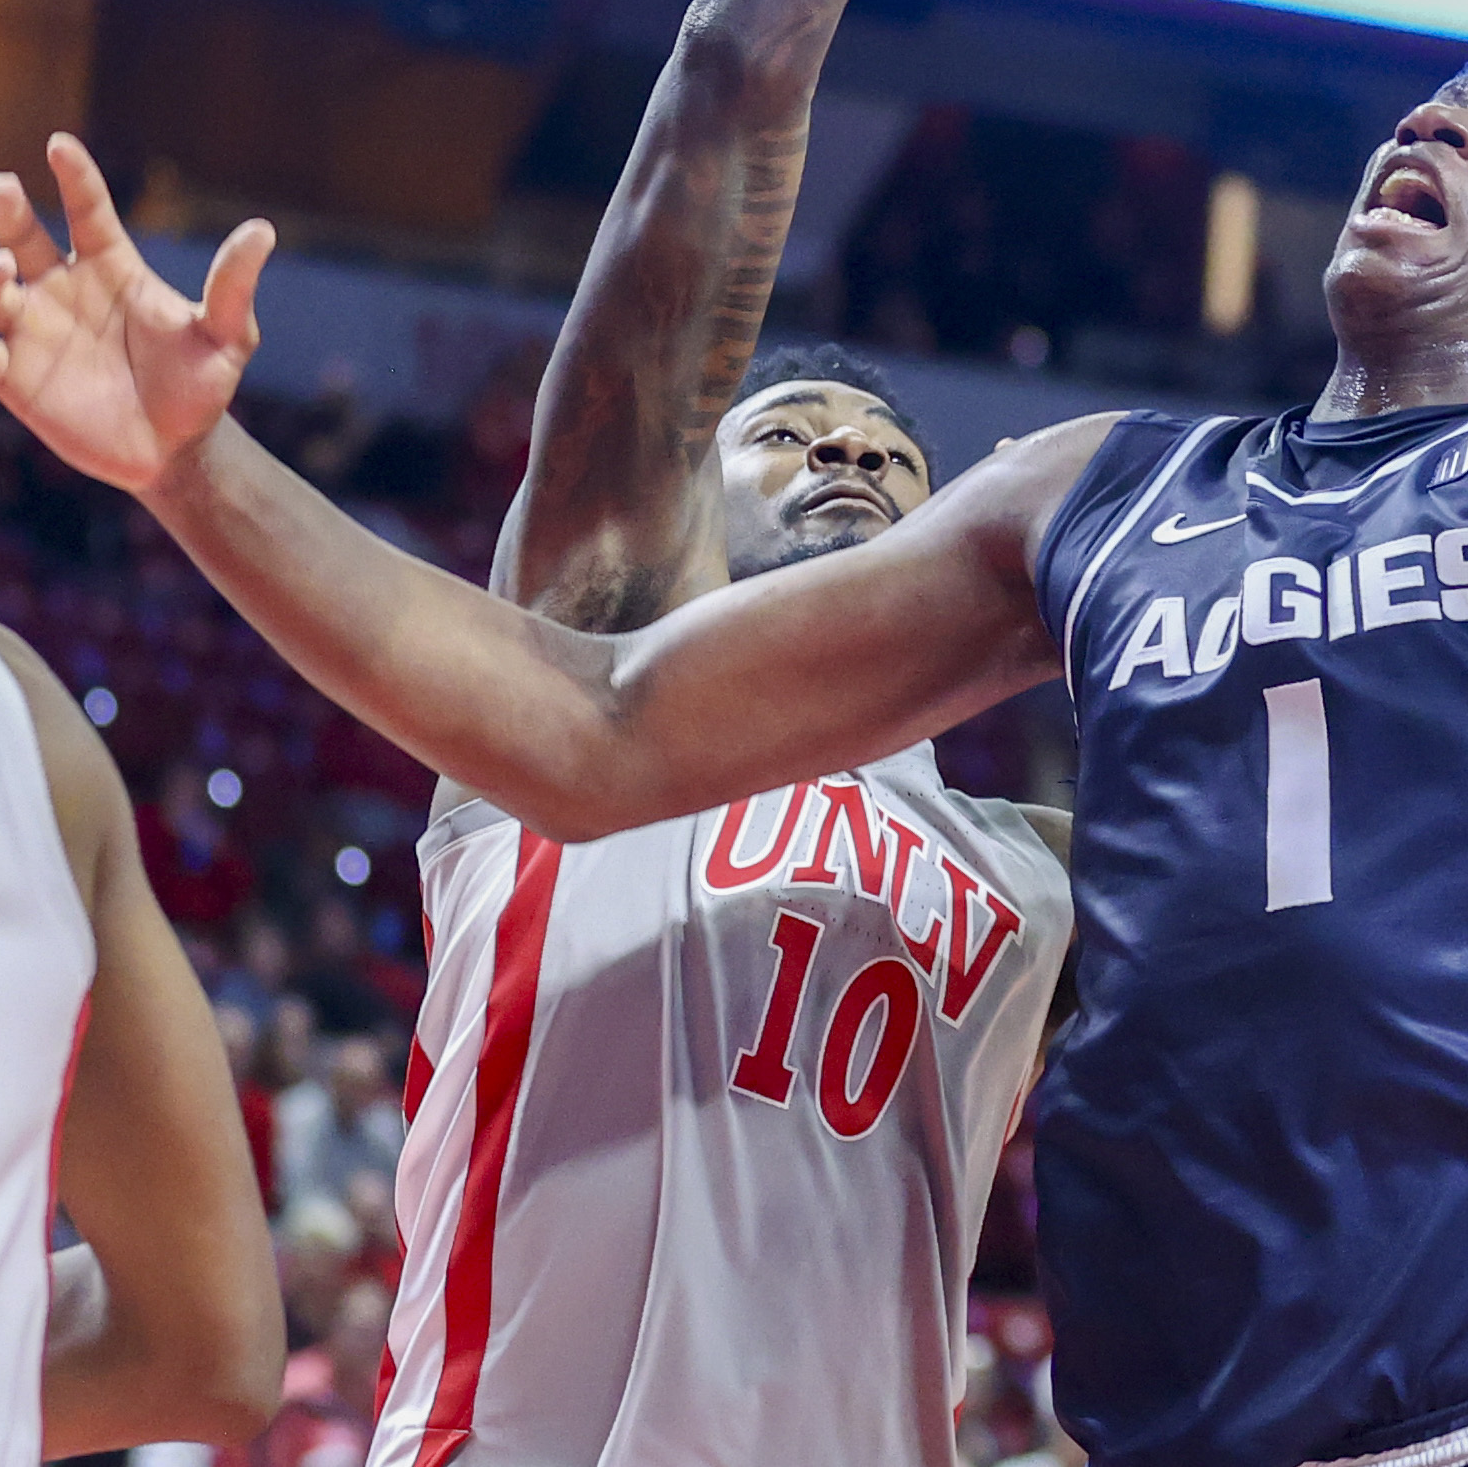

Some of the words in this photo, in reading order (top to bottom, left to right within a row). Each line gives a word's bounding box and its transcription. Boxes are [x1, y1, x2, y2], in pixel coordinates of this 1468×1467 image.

[699, 778, 1027, 1029] UNLV
[1263, 677, 1333, 912] 1
[728, 907, 923, 1142] 10
